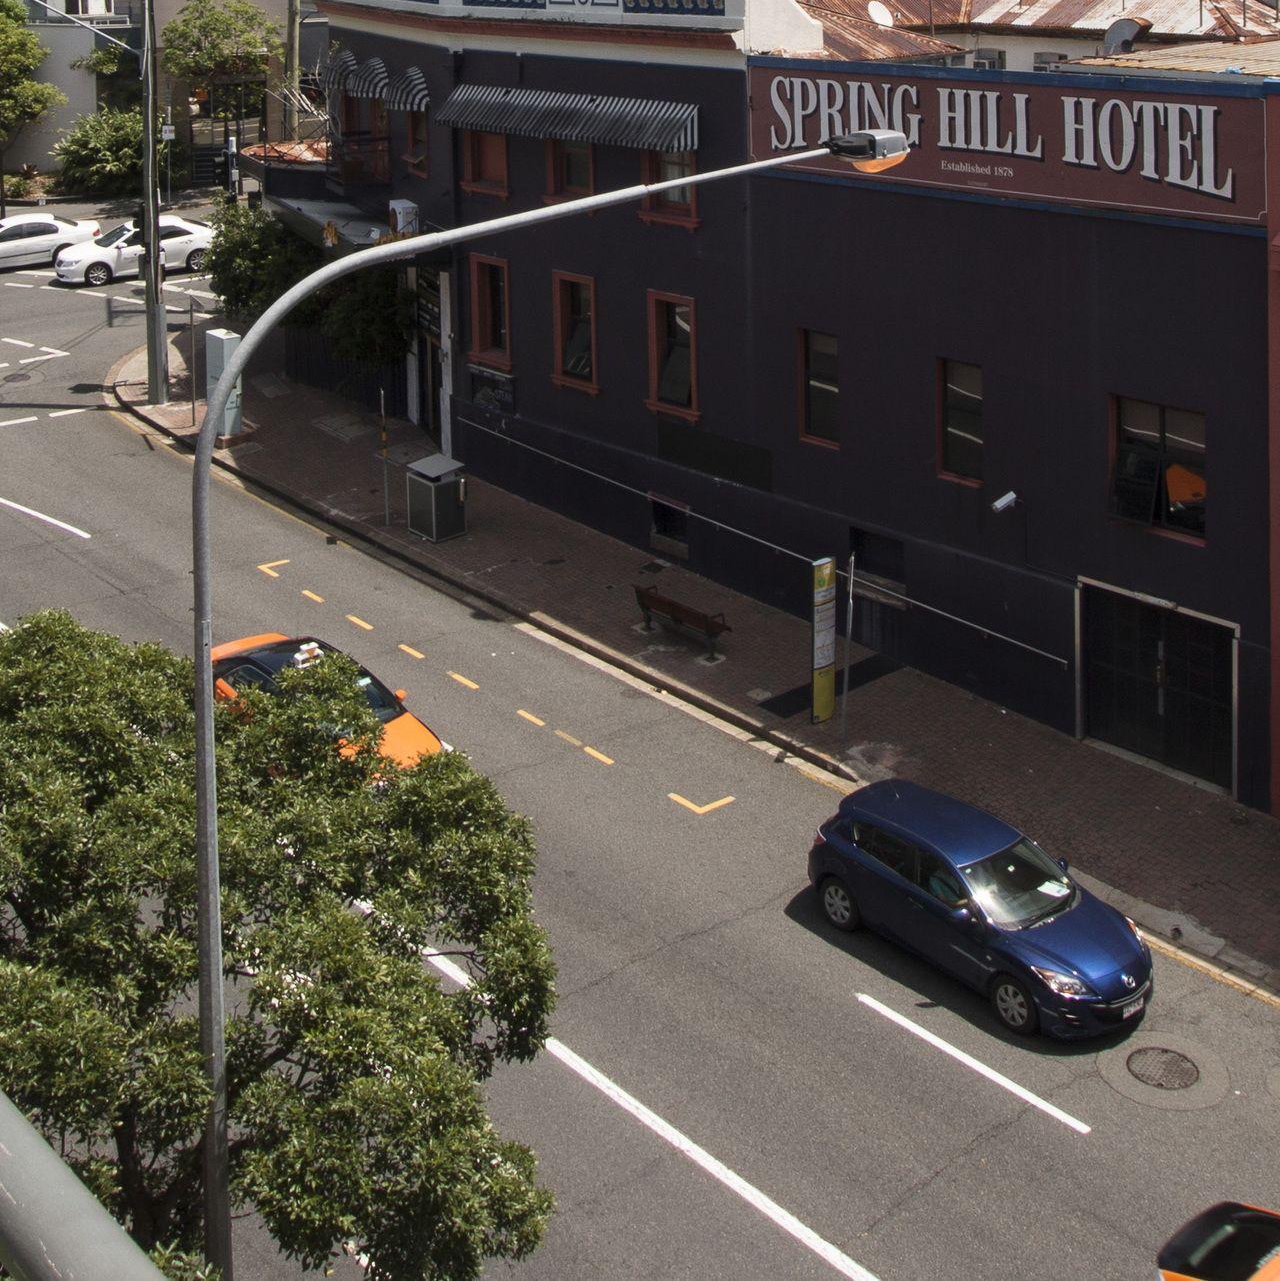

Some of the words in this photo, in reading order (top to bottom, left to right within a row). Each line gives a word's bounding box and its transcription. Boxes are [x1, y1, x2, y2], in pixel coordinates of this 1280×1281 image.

[770, 75, 922, 150] SPRING
[937, 87, 1043, 159] HILL
[1061, 95, 1234, 200] HOTEL
[941, 160, 991, 176] Established
[993, 166, 1014, 178] 1878
